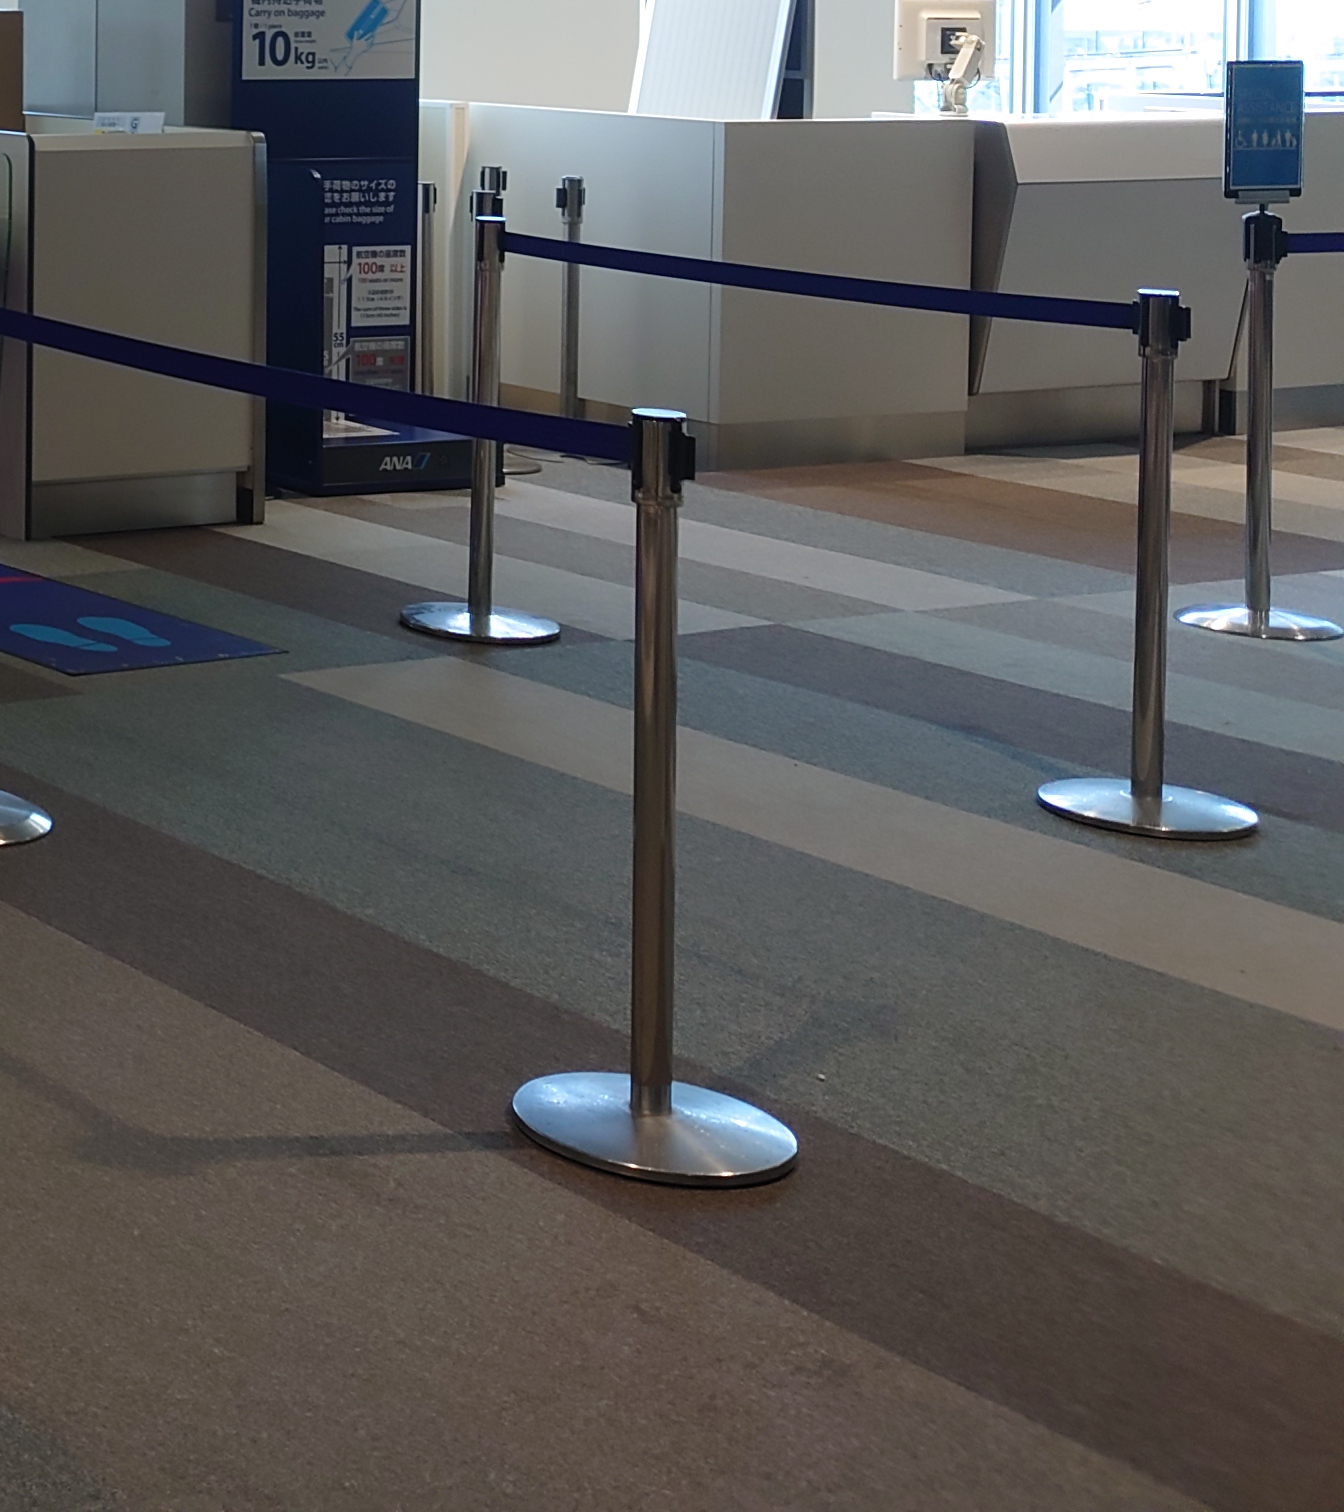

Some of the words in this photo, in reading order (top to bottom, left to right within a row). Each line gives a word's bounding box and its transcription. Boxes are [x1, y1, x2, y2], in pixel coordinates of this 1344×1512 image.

[248, 7, 272, 19] Carry
[274, 9, 285, 18] on
[287, 7, 326, 20] baggage
[252, 30, 291, 67] 10
[294, 46, 316, 70] kg
[338, 205, 361, 214] check
[362, 205, 371, 213] the
[372, 205, 385, 213] size
[386, 204, 394, 213] of
[331, 214, 351, 223] cabin
[352, 214, 384, 224] baggage
[333, 332, 344, 342] 55
[379, 455, 412, 471] ANA
